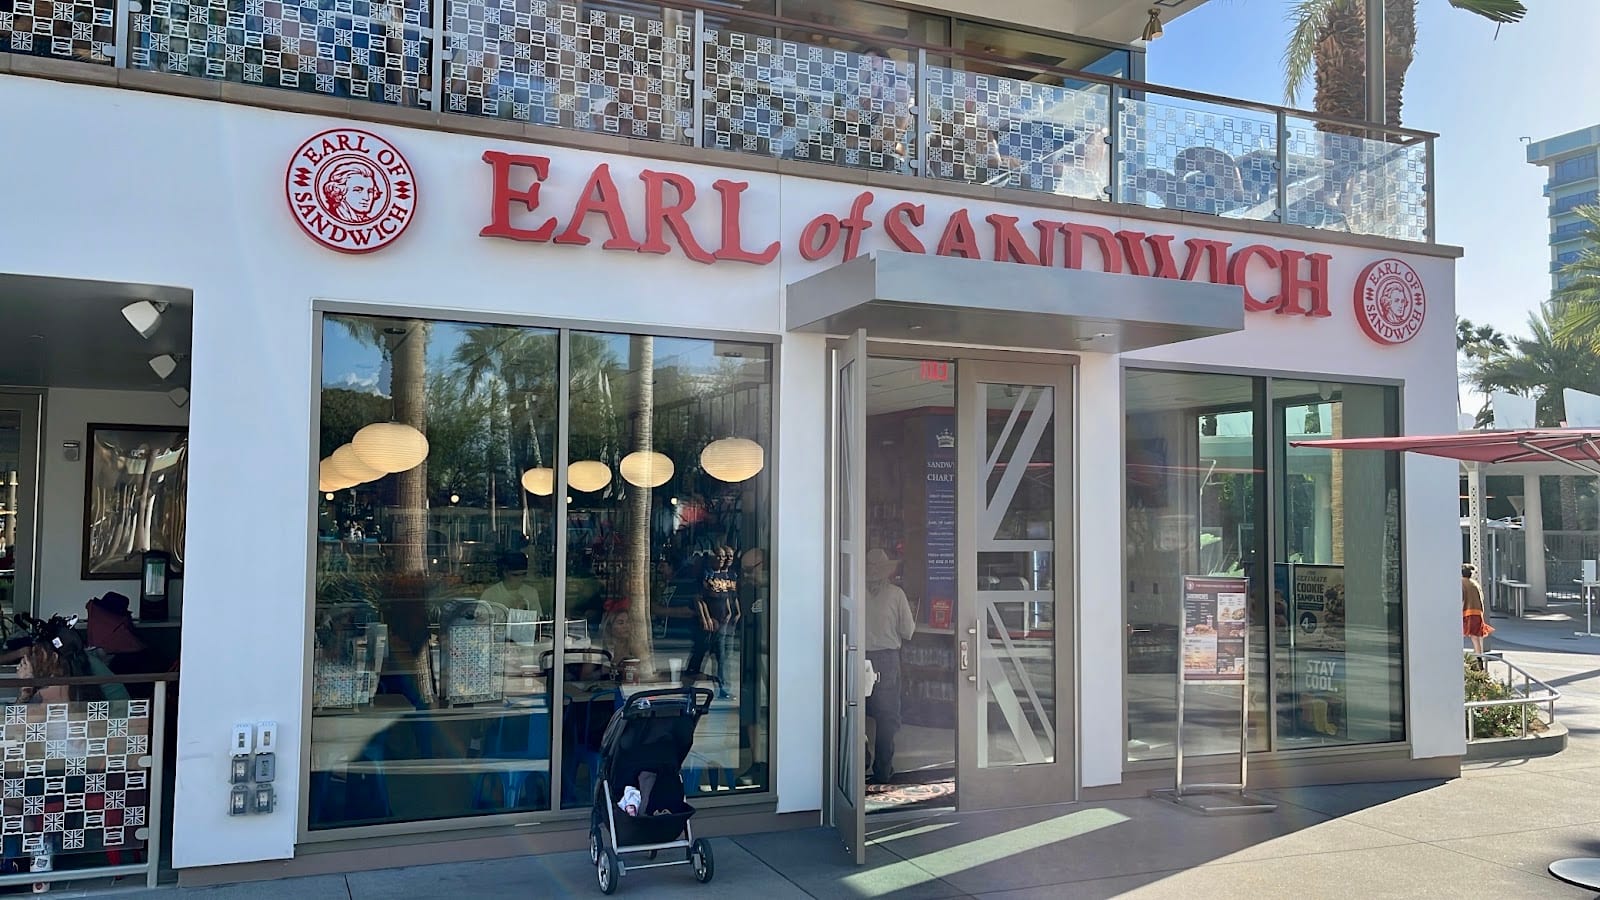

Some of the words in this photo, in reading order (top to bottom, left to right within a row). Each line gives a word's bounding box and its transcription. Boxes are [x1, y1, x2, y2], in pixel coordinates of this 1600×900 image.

[303, 134, 370, 166] EARL
[377, 149, 406, 176] OF
[294, 191, 409, 246] SANDWICH
[479, 150, 781, 265] EARL
[799, 191, 874, 263] of
[884, 202, 1332, 317] SANDWICH
[1369, 263, 1401, 286] EARL
[1405, 271, 1420, 290] OF
[1366, 304, 1422, 340] SANDWICH
[1297, 582, 1325, 593] COOKIE
[1306, 659, 1336, 676] STAY
[1305, 675, 1338, 692] COOL.
